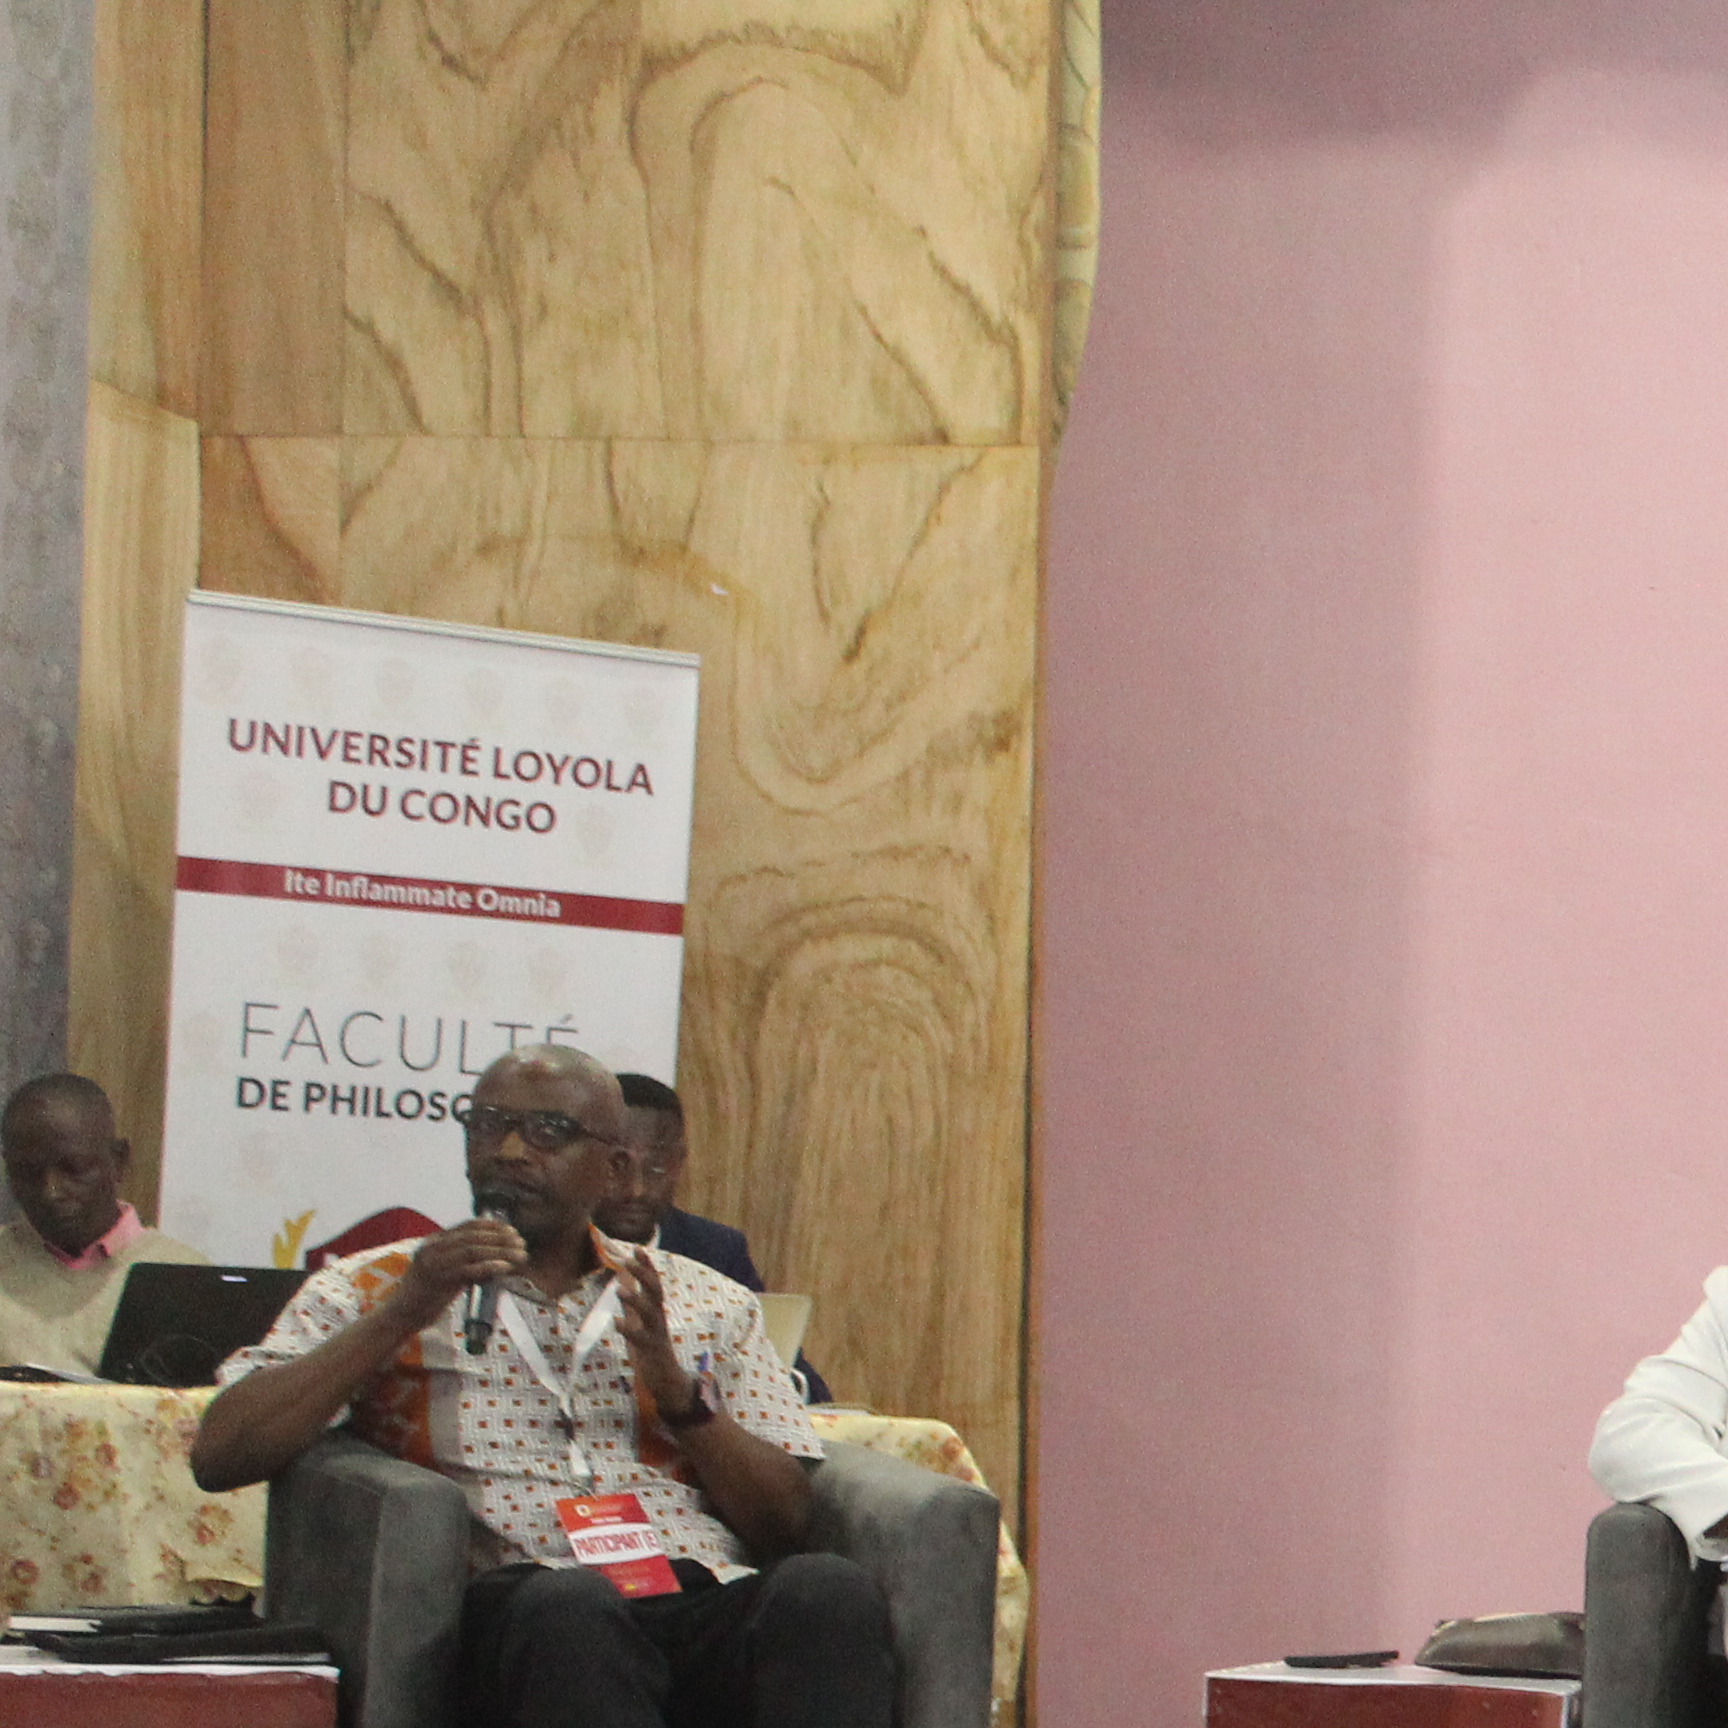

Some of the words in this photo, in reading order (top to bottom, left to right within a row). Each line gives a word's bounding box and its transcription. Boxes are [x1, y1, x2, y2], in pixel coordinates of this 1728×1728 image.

[227, 717, 482, 778] UNIVERSITÉ
[492, 745, 655, 796] LOYOLA
[327, 780, 390, 818] DU
[399, 788, 558, 834] CONGO
[284, 868, 322, 896] Ite
[326, 872, 473, 910] Inflammate
[477, 887, 562, 919] Omnia
[236, 1075, 292, 1112] DE
